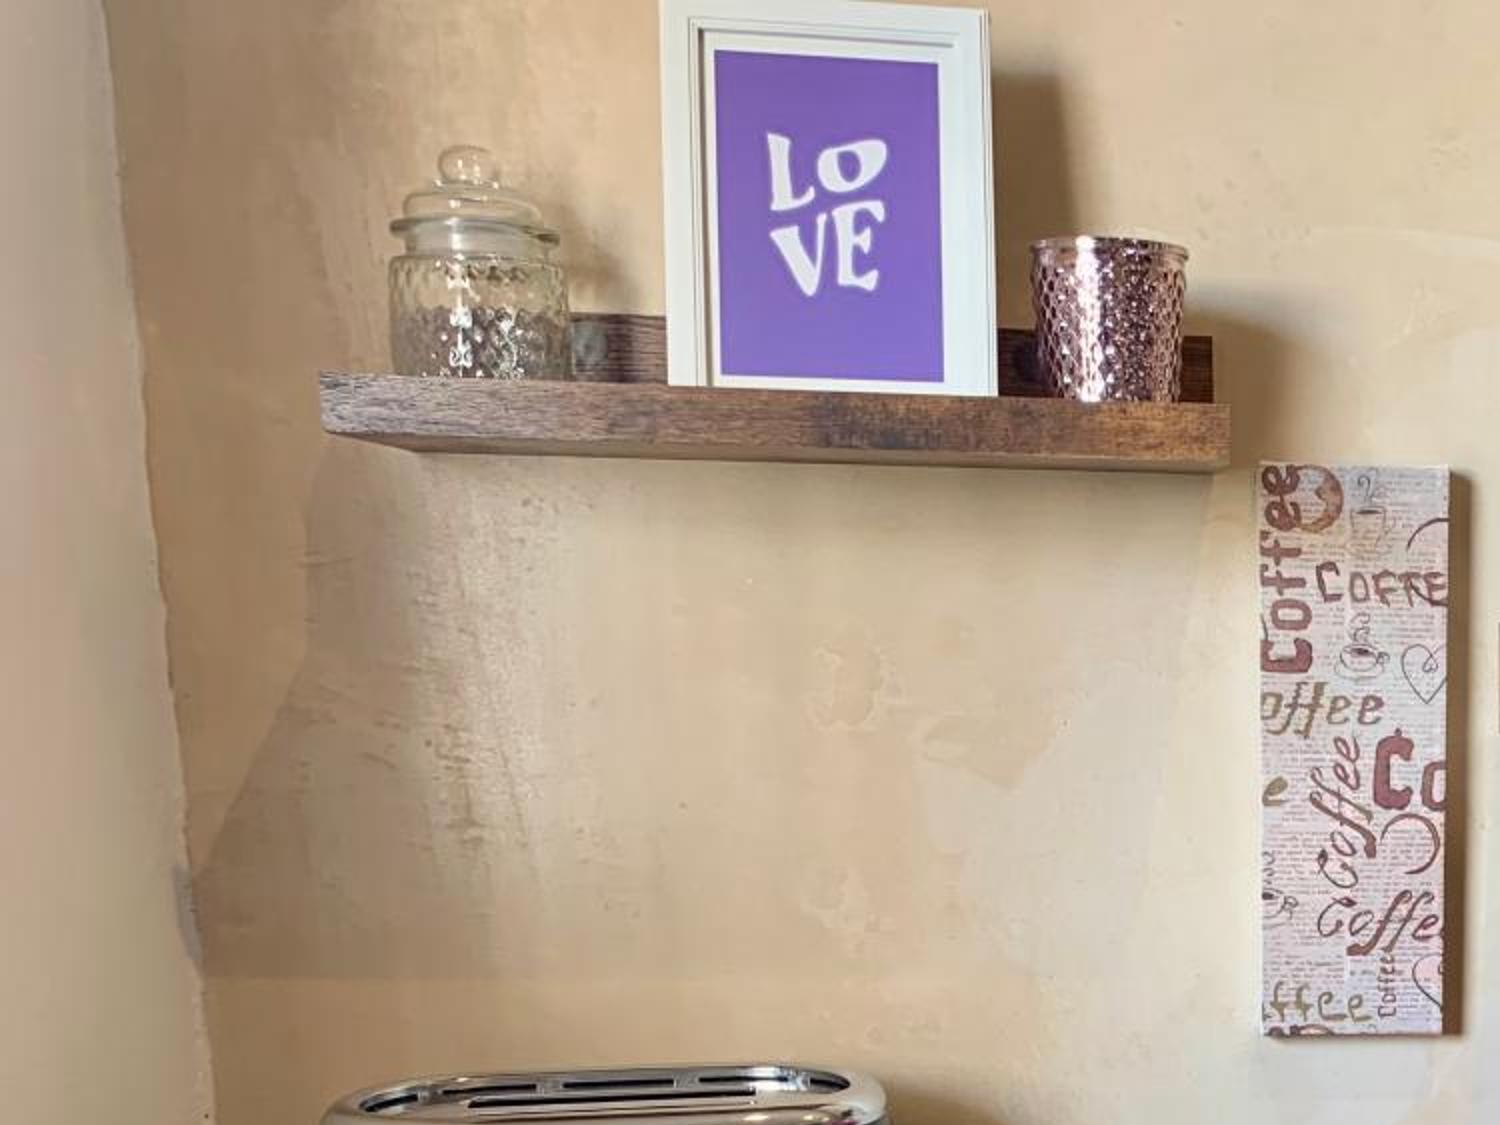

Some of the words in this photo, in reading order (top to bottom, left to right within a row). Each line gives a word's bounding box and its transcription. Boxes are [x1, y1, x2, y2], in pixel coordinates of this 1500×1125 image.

[1260, 464, 1312, 674] Coffee
[1309, 736, 1377, 889] Coffee
[1316, 889, 1443, 956] Coffe
